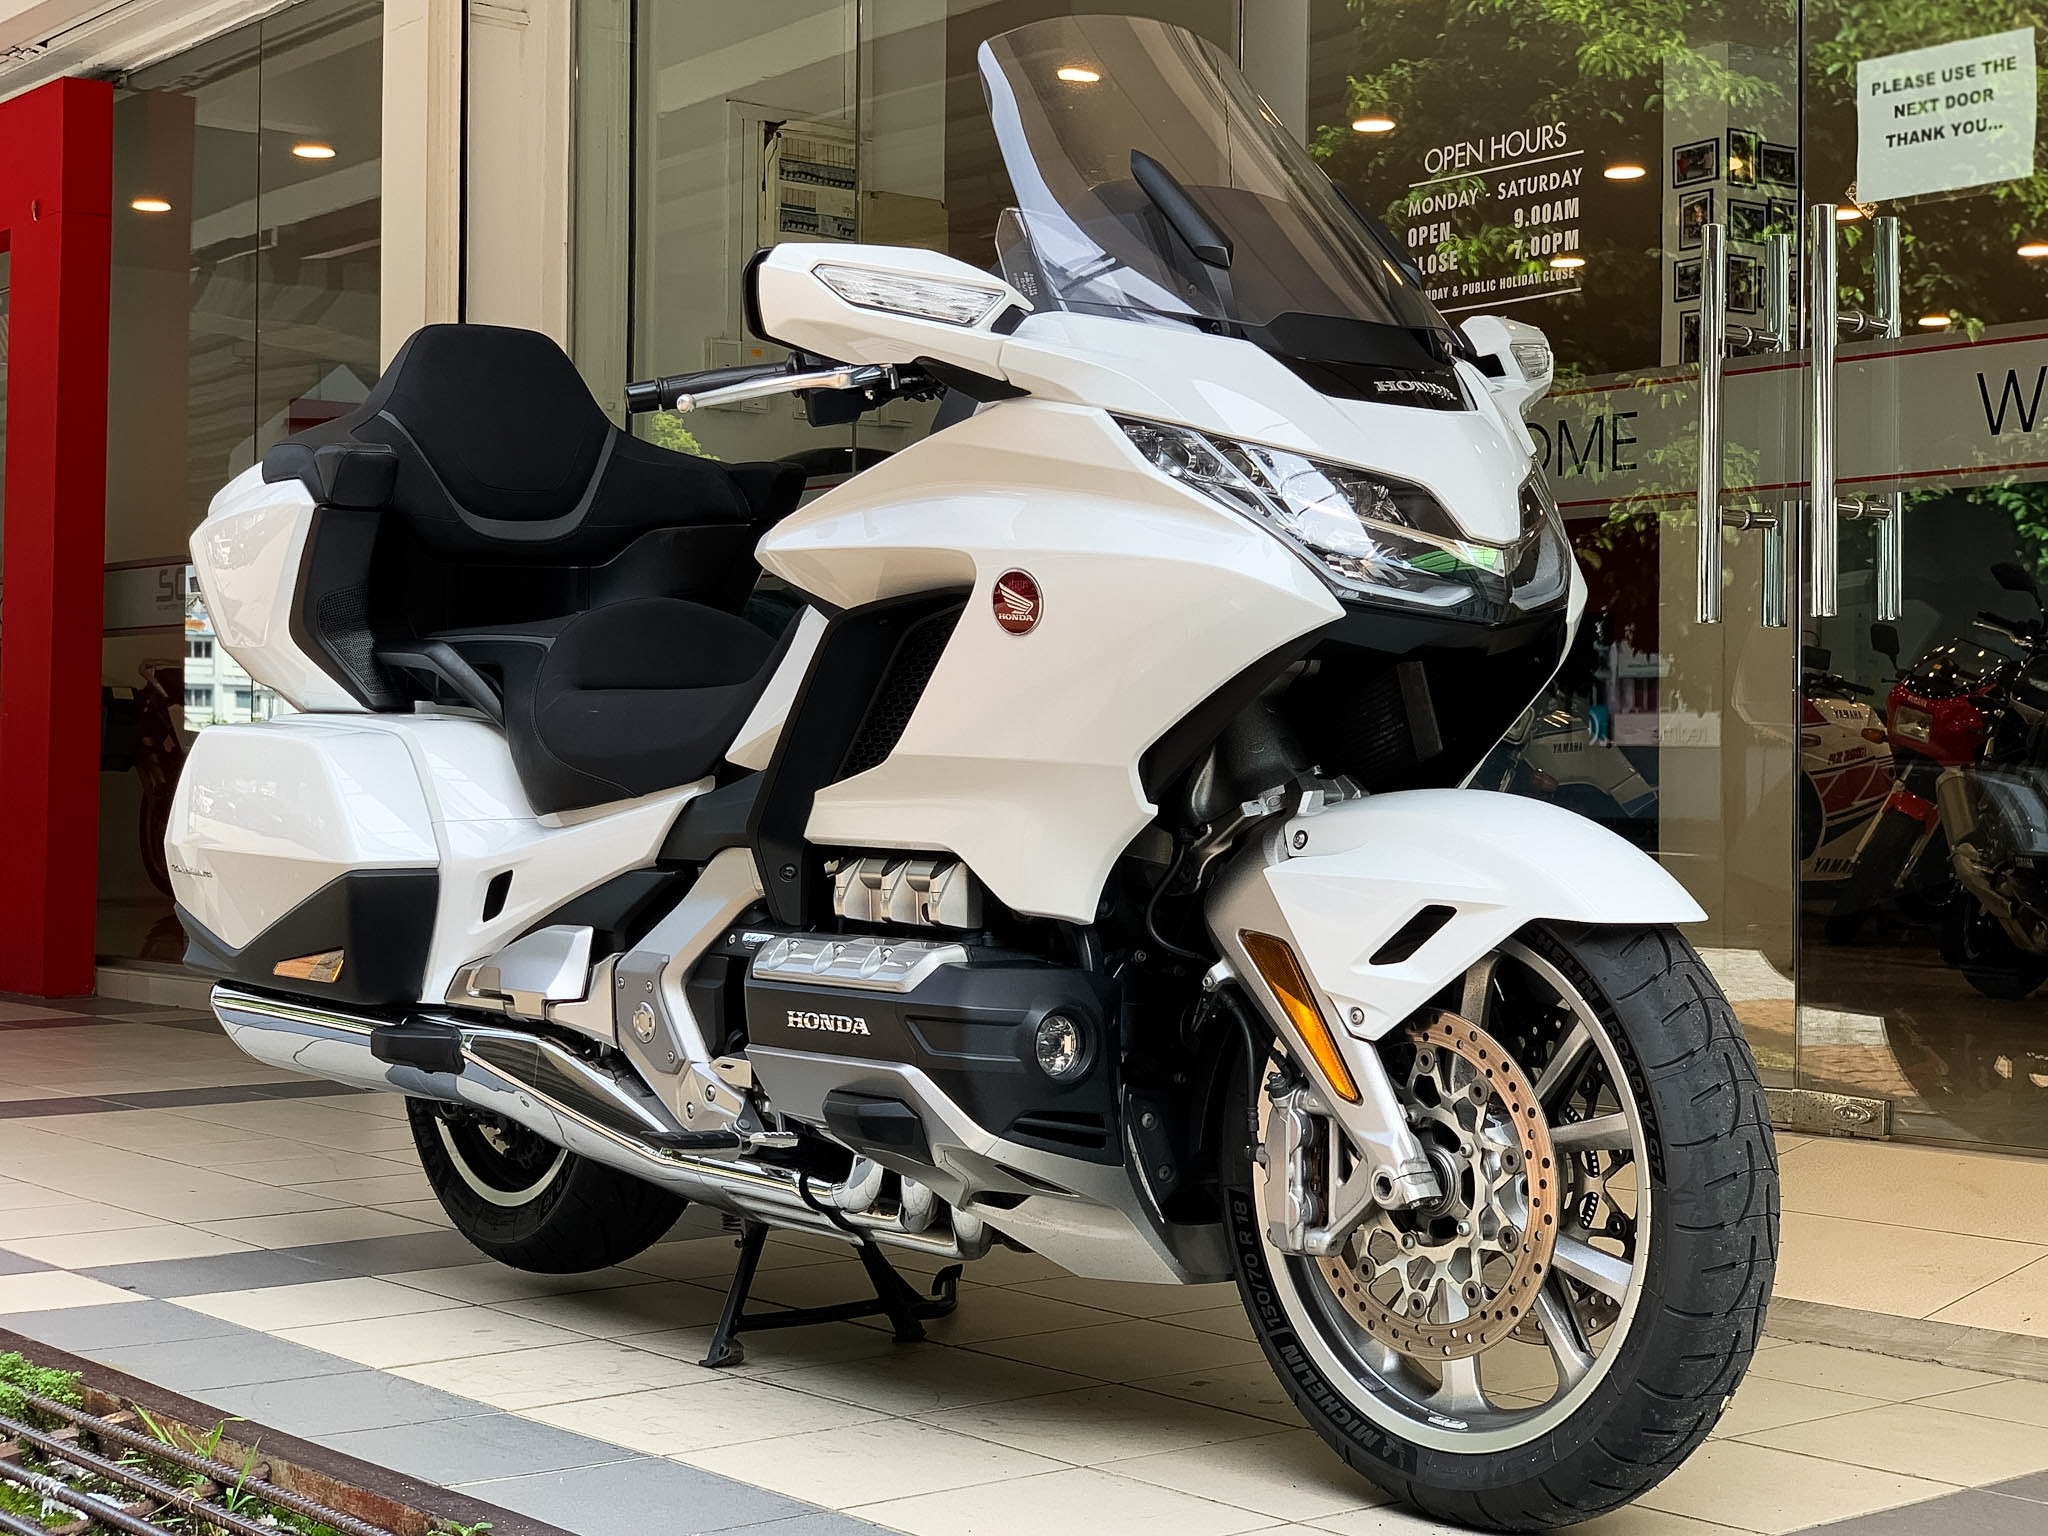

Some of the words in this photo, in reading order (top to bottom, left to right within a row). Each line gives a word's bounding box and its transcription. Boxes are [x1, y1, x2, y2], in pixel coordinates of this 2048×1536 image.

[1871, 71, 1936, 97] PLEASE
[1941, 64, 1976, 83] USE
[1981, 56, 2017, 75] THE
[1893, 98, 1940, 119] NEXT
[1945, 88, 1995, 110] DOOR
[1424, 138, 1484, 174] OPEN
[1490, 121, 1568, 161] HOURS
[1885, 125, 1945, 148] THANK
[1951, 117, 2004, 137] YOU...
[1407, 187, 1479, 218] MONDAY
[1497, 167, 1583, 201] SATURDAY
[1407, 221, 1451, 248] OPEN
[1513, 197, 1580, 229] 9.00AM
[1411, 250, 1458, 276] LOSE
[1513, 229, 1579, 260] 7.00PM
[1451, 285, 1459, 297] &
[1462, 279, 1496, 296] PUBLIC
[1499, 271, 1540, 290] HOLIDAY
[1543, 266, 1575, 283] CLOSE
[1373, 380, 1458, 401] HONDA
[998, 612, 1035, 622] HONDA
[1832, 708, 1864, 721] YAMAHA
[1552, 742, 1584, 754] YAMAHA
[786, 1010, 872, 1036] HONDA
[1606, 1021, 1645, 1095] ROAD
[1233, 1200, 1250, 1226] 18
[1238, 1231, 1254, 1246] R
[1243, 1253, 1282, 1328] 130/70
[1279, 1344, 1381, 1449] MICHELIN
